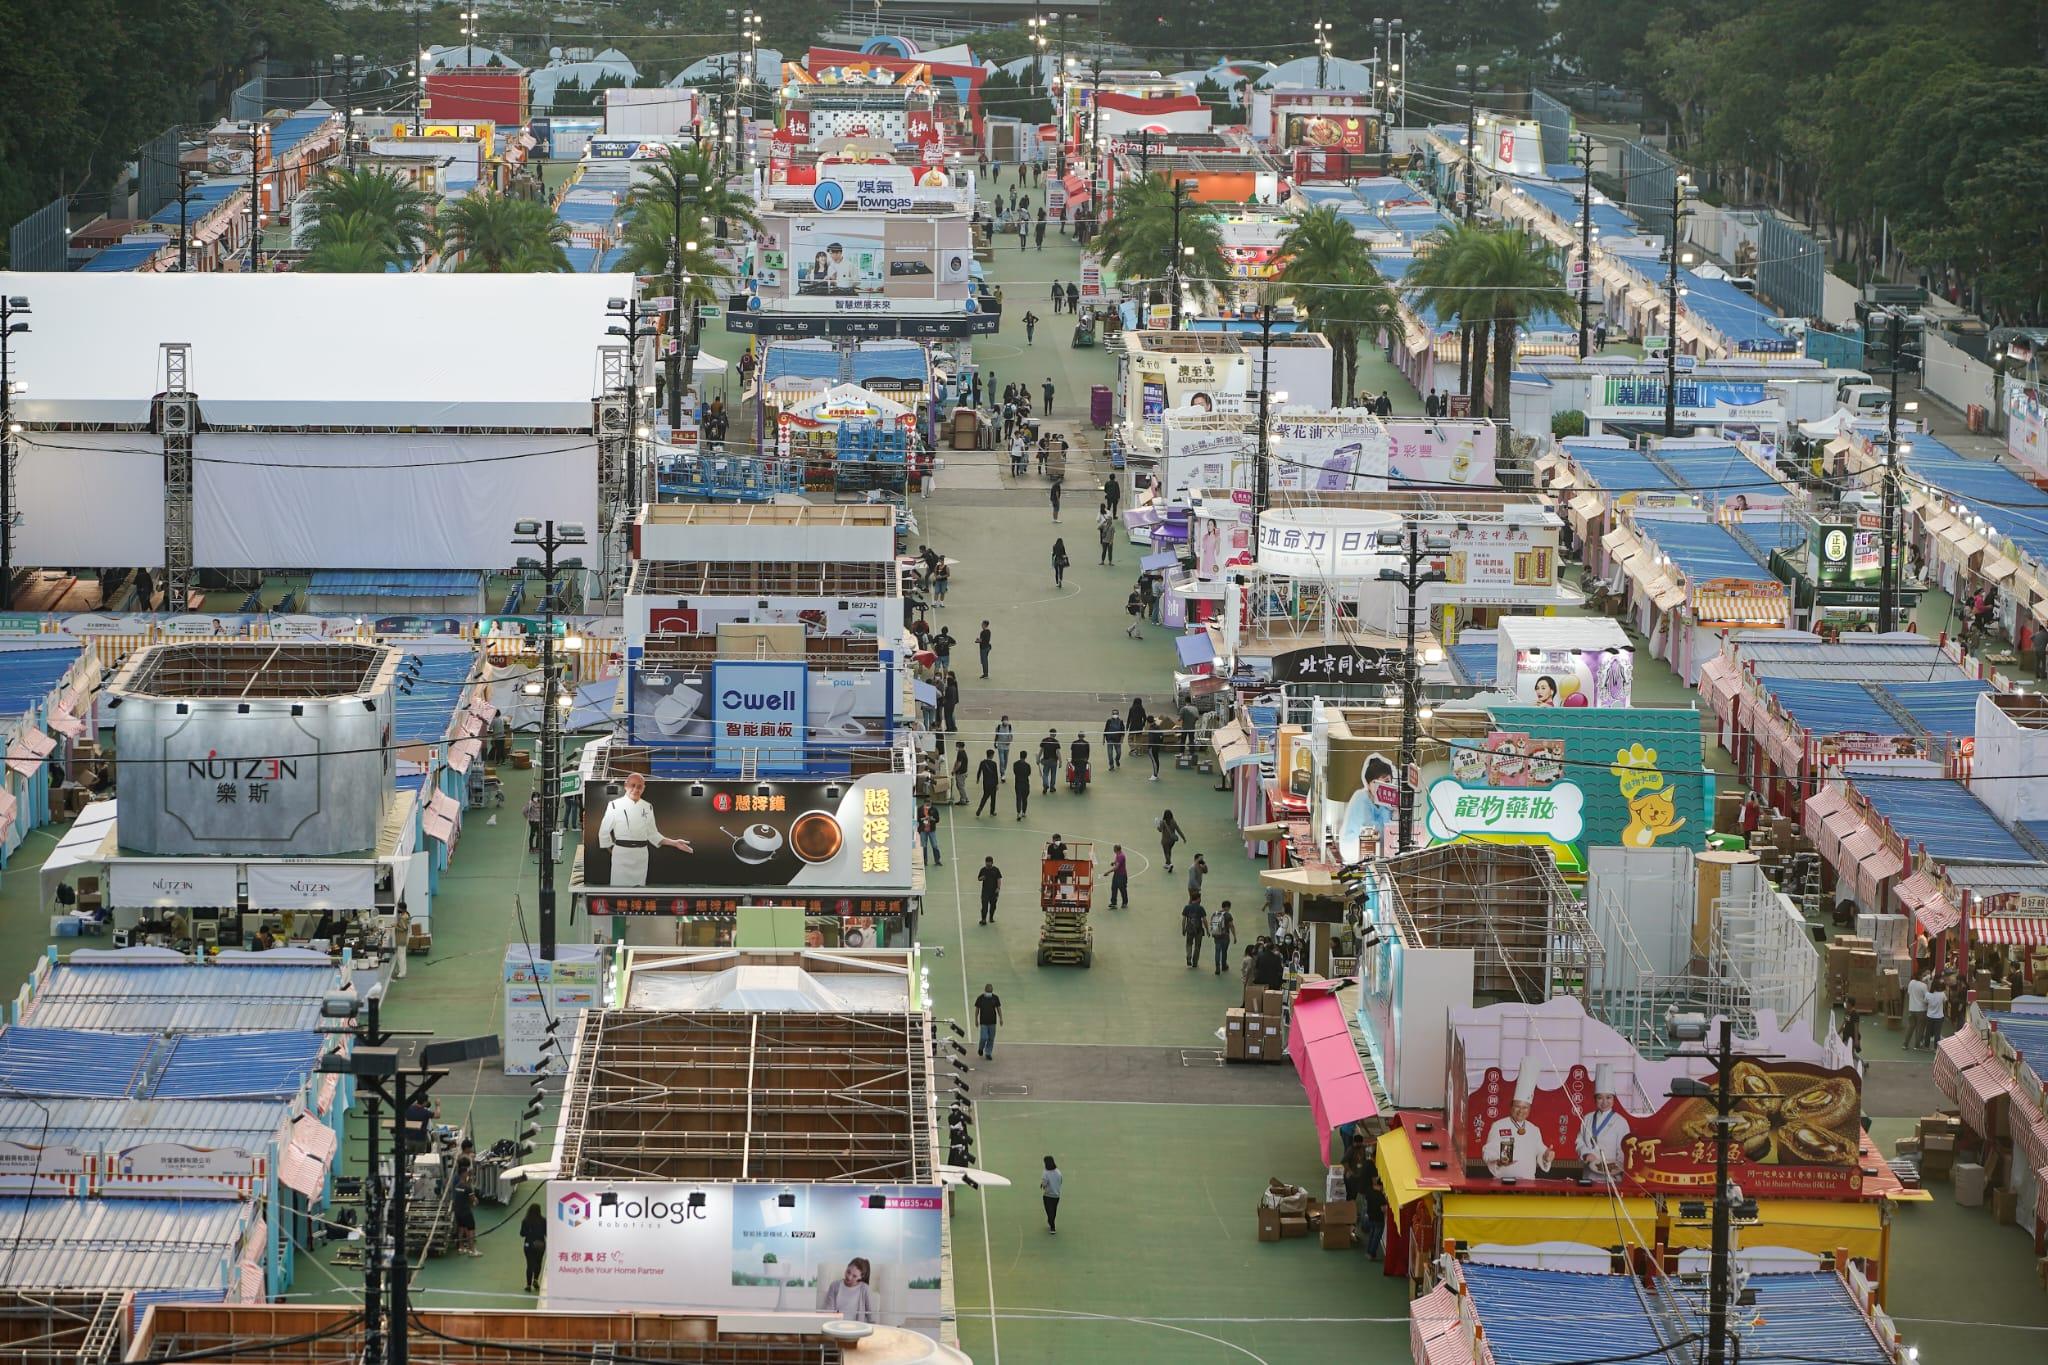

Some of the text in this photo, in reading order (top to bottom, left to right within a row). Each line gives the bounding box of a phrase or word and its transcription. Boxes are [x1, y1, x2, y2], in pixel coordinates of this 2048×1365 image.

[857, 180, 893, 194] 煤氣
[858, 195, 911, 209] Towngas
[1277, 424, 1322, 439] 紫花油
[1259, 525, 1326, 550] 日本命力
[1832, 535, 1841, 555] 正品
[726, 722, 793, 737] 智能廁板
[735, 795, 786, 812] 懸浮鑊
[1455, 795, 1558, 826] 寵物藥妝
[862, 788, 890, 873] 懸浮鑊
[558, 1252, 607, 1262] 有你真好
[558, 1266, 583, 1274] Always
[638, 1267, 664, 1275] Partner
